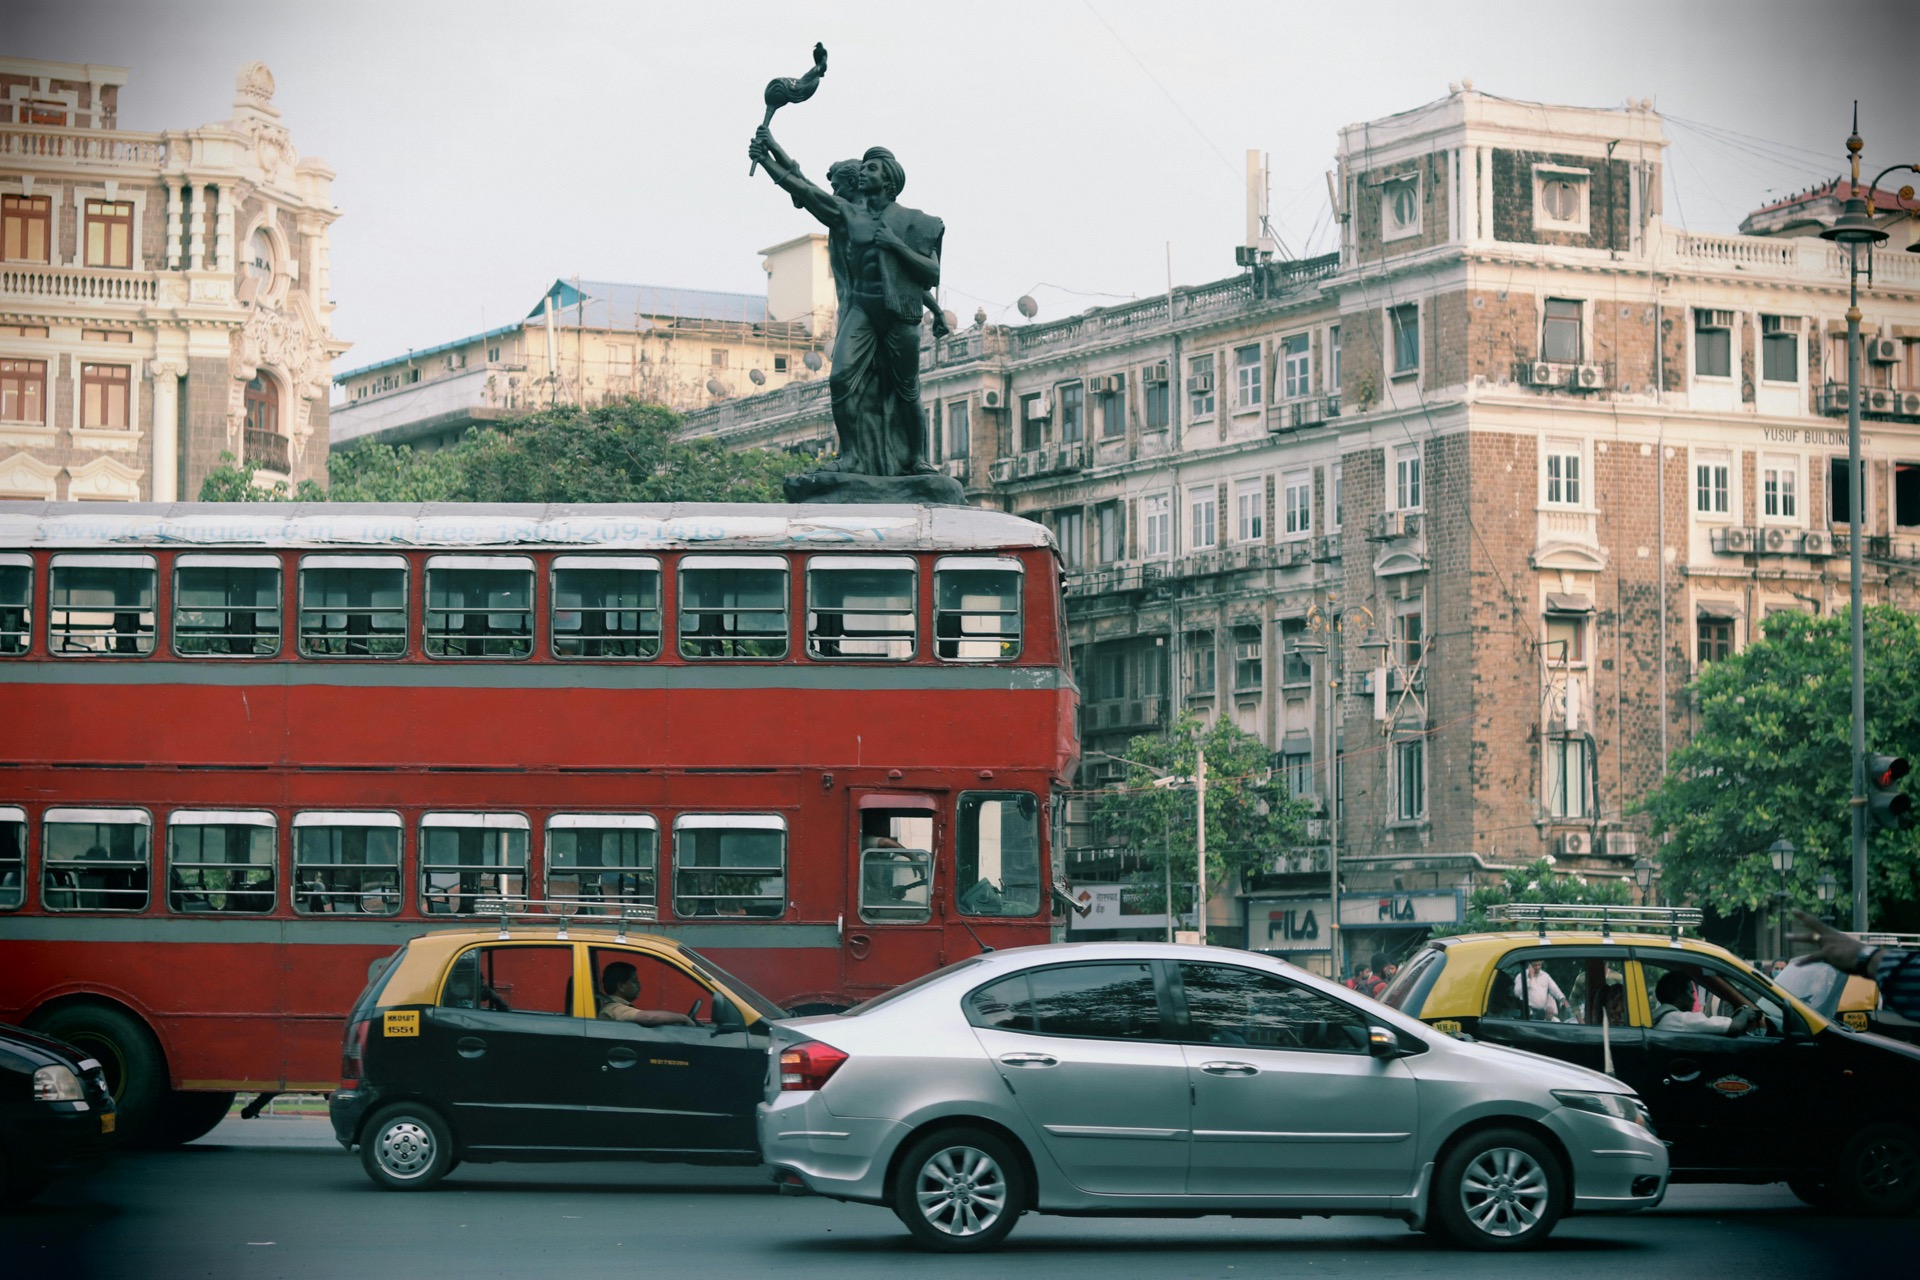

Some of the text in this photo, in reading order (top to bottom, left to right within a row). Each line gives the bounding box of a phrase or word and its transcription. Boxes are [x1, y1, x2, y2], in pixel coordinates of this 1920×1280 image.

[1764, 428, 1799, 443] YUSUF
[498, 521, 726, 542] 1800-209-1415
[1378, 899, 1416, 921] FILA
[1268, 909, 1319, 941] FILA
[388, 1026, 415, 1034] 1551
